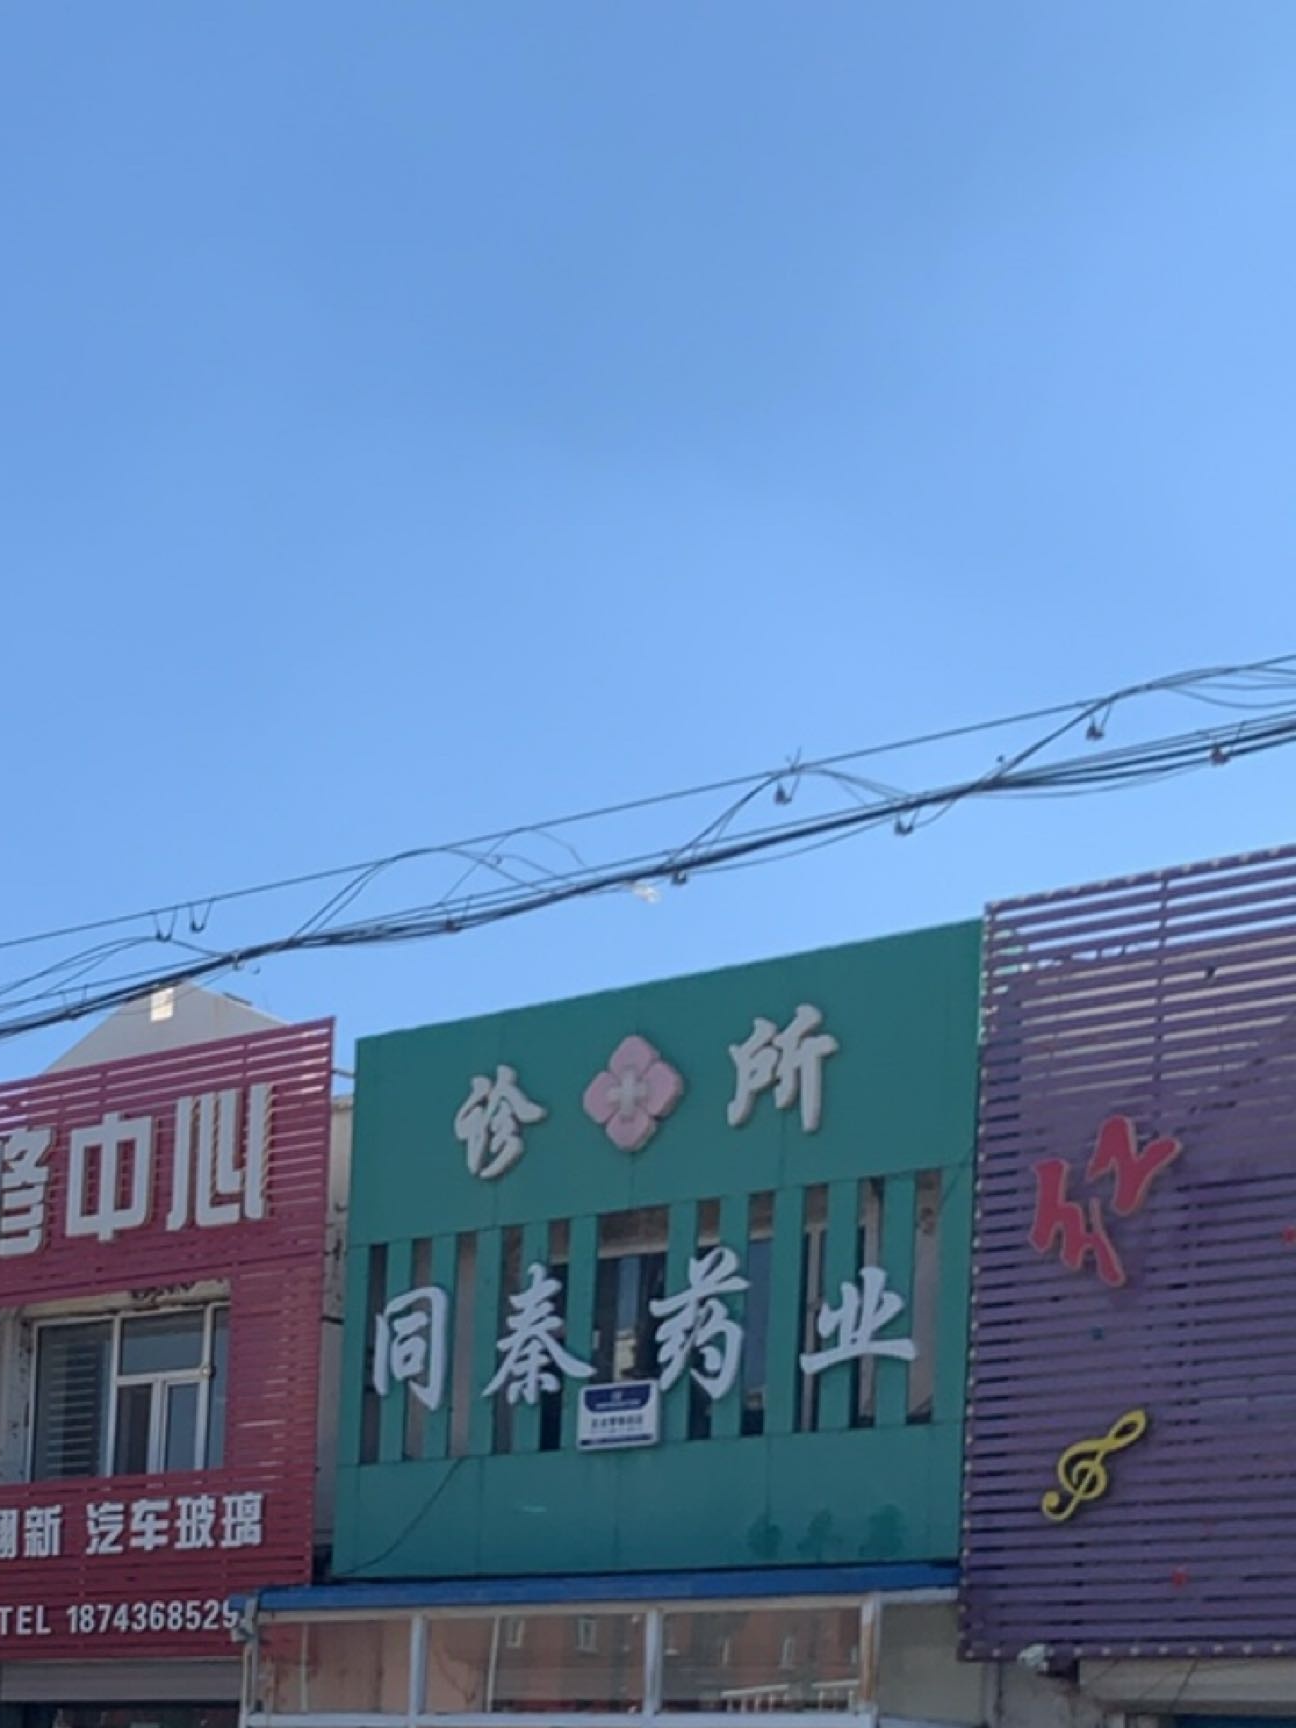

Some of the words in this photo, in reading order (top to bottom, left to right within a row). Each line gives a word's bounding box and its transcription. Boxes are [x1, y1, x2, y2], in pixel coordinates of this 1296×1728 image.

[454, 1003, 838, 1179] 诊所
[374, 1247, 917, 1411] 同秦药业
[85, 1492, 264, 1556] 汽车玻璃
